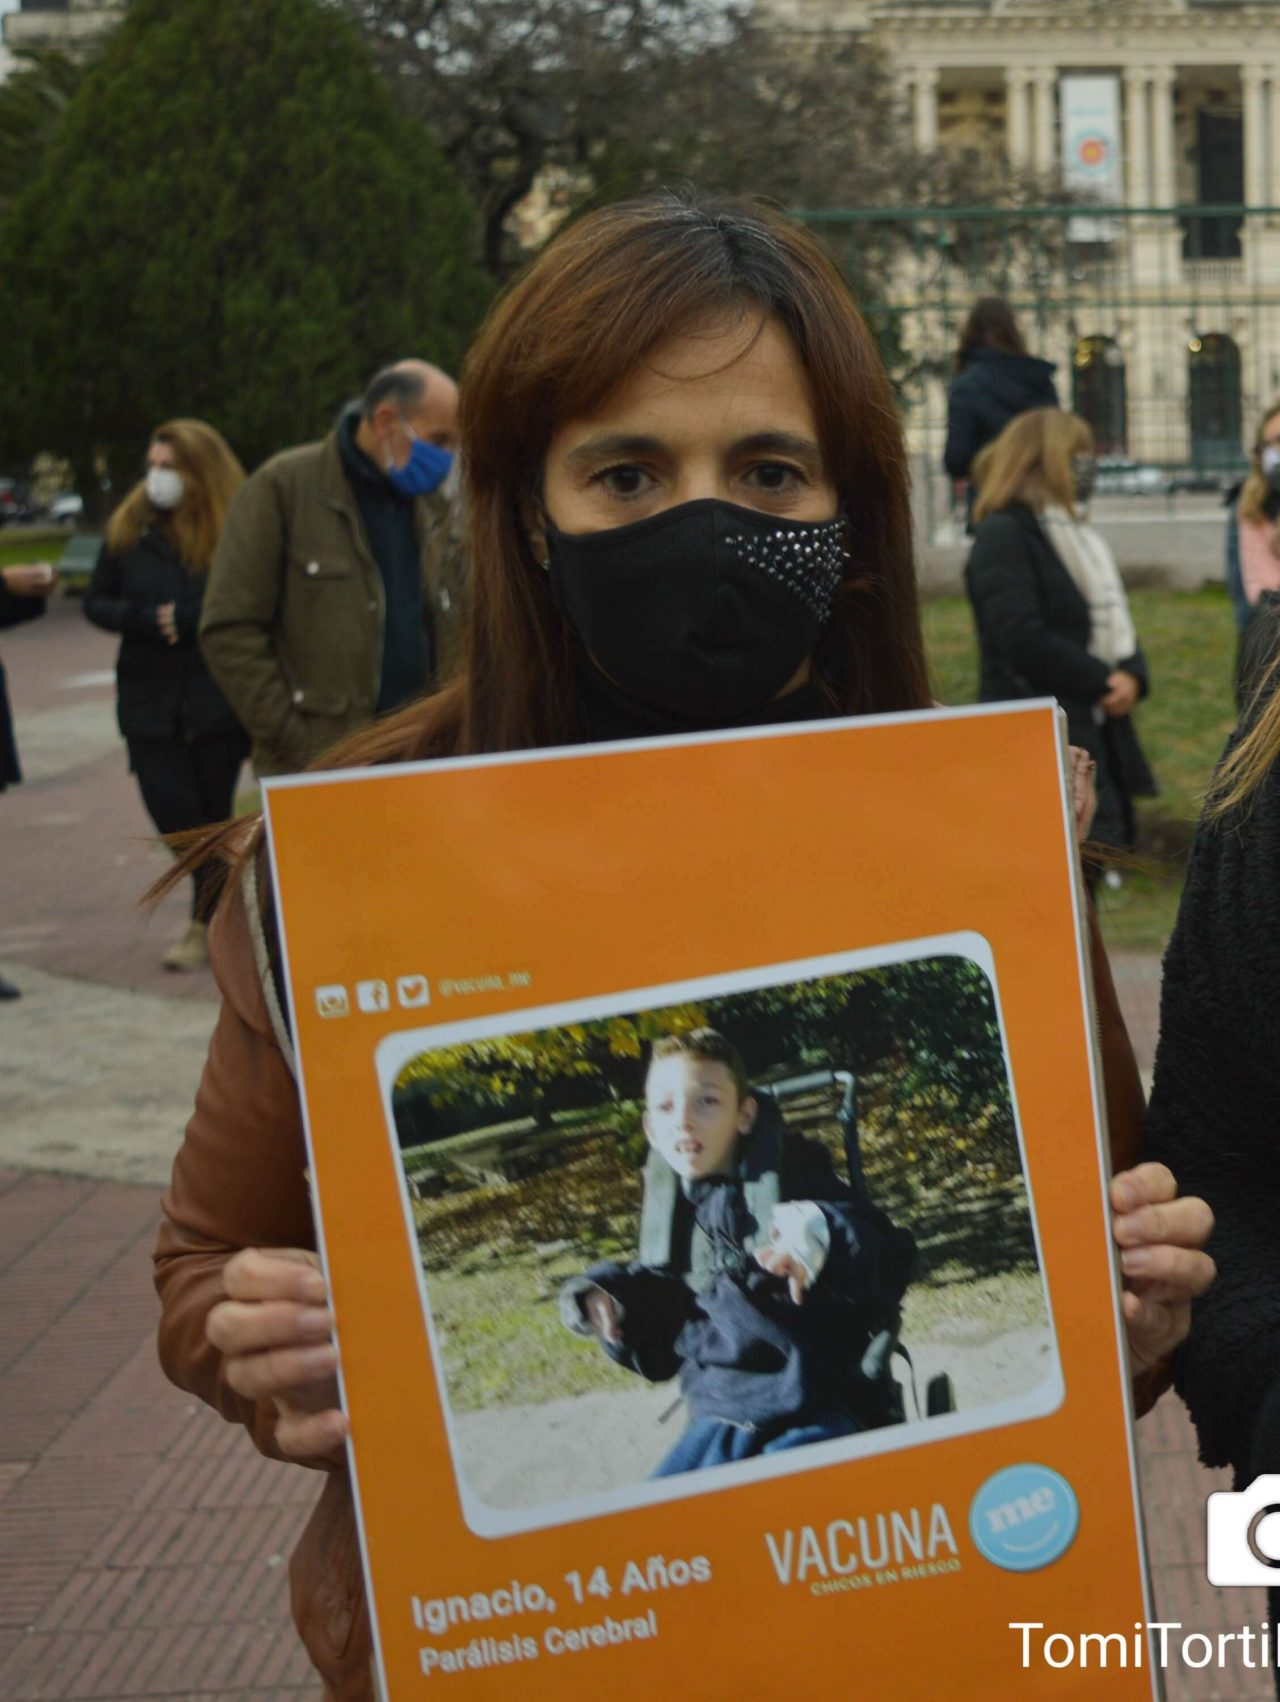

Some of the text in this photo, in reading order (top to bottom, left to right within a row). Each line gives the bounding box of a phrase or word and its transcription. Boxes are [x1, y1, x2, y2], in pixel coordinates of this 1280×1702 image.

[764, 1486, 1056, 1585] VACUNA me
[411, 1554, 712, 1635] Ignacio, 14 Años
[809, 1558, 961, 1596] CHICOS EN RIESGO
[419, 1608, 658, 1676] Parálisis Cerebral
